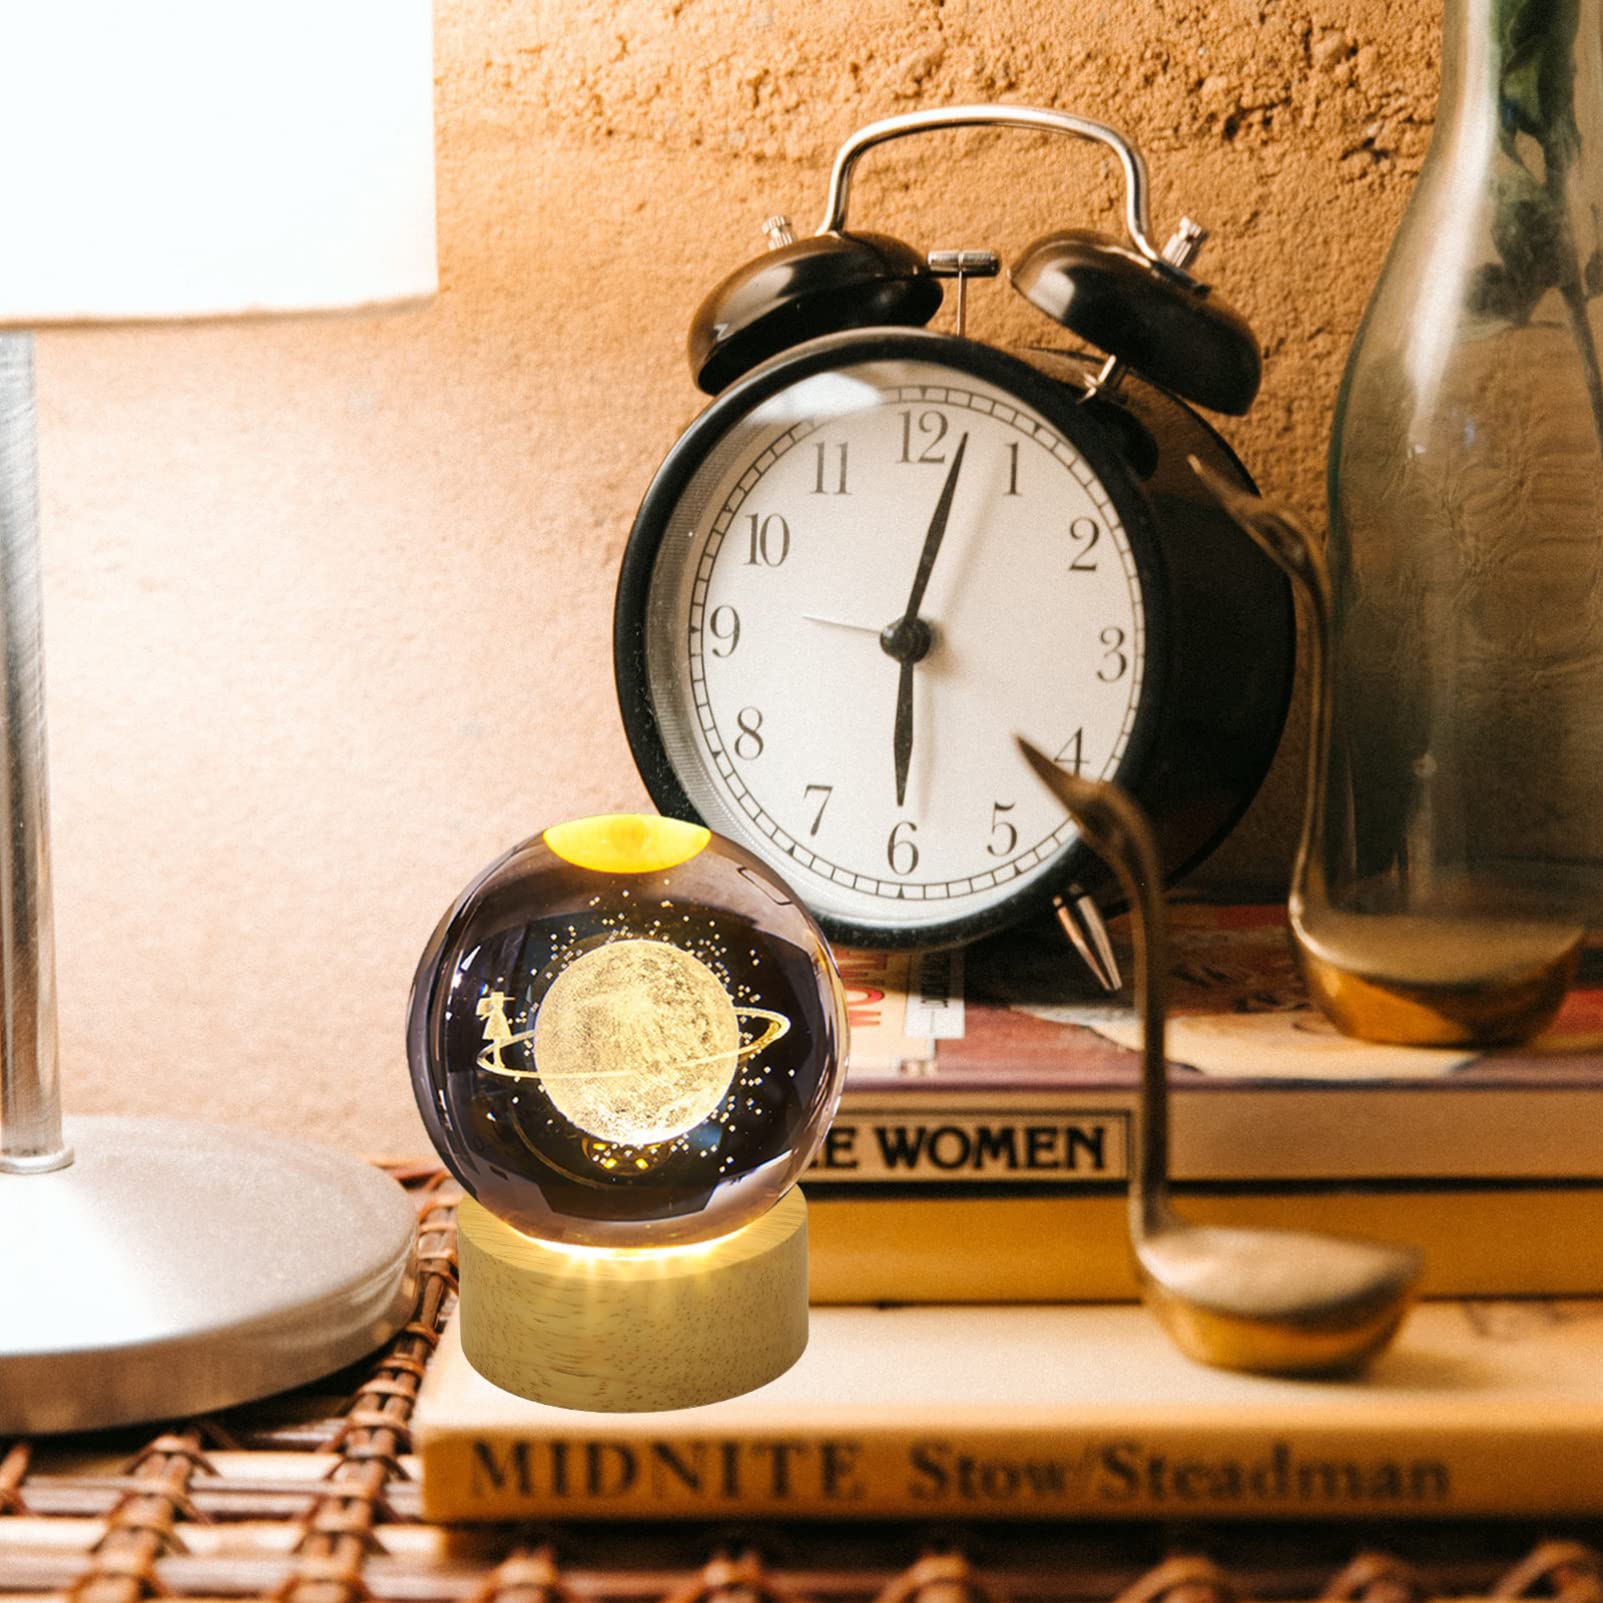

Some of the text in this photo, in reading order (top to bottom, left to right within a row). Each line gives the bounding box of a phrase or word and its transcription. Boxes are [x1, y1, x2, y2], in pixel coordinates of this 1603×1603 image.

[896, 409, 949, 465] 12
[810, 440, 854, 496] 11
[1003, 441, 1025, 497] 1
[743, 512, 791, 568] 10
[1068, 516, 1101, 573] 2
[709, 604, 741, 658] 9
[1096, 626, 1128, 683] 3
[733, 706, 765, 761] 8
[1053, 727, 1090, 782] 4
[802, 784, 834, 837] 7
[986, 801, 1019, 857] 5
[886, 820, 920, 877] 6
[874, 1125, 1106, 1171] WOMEN
[470, 1439, 866, 1500] MIDNITE
